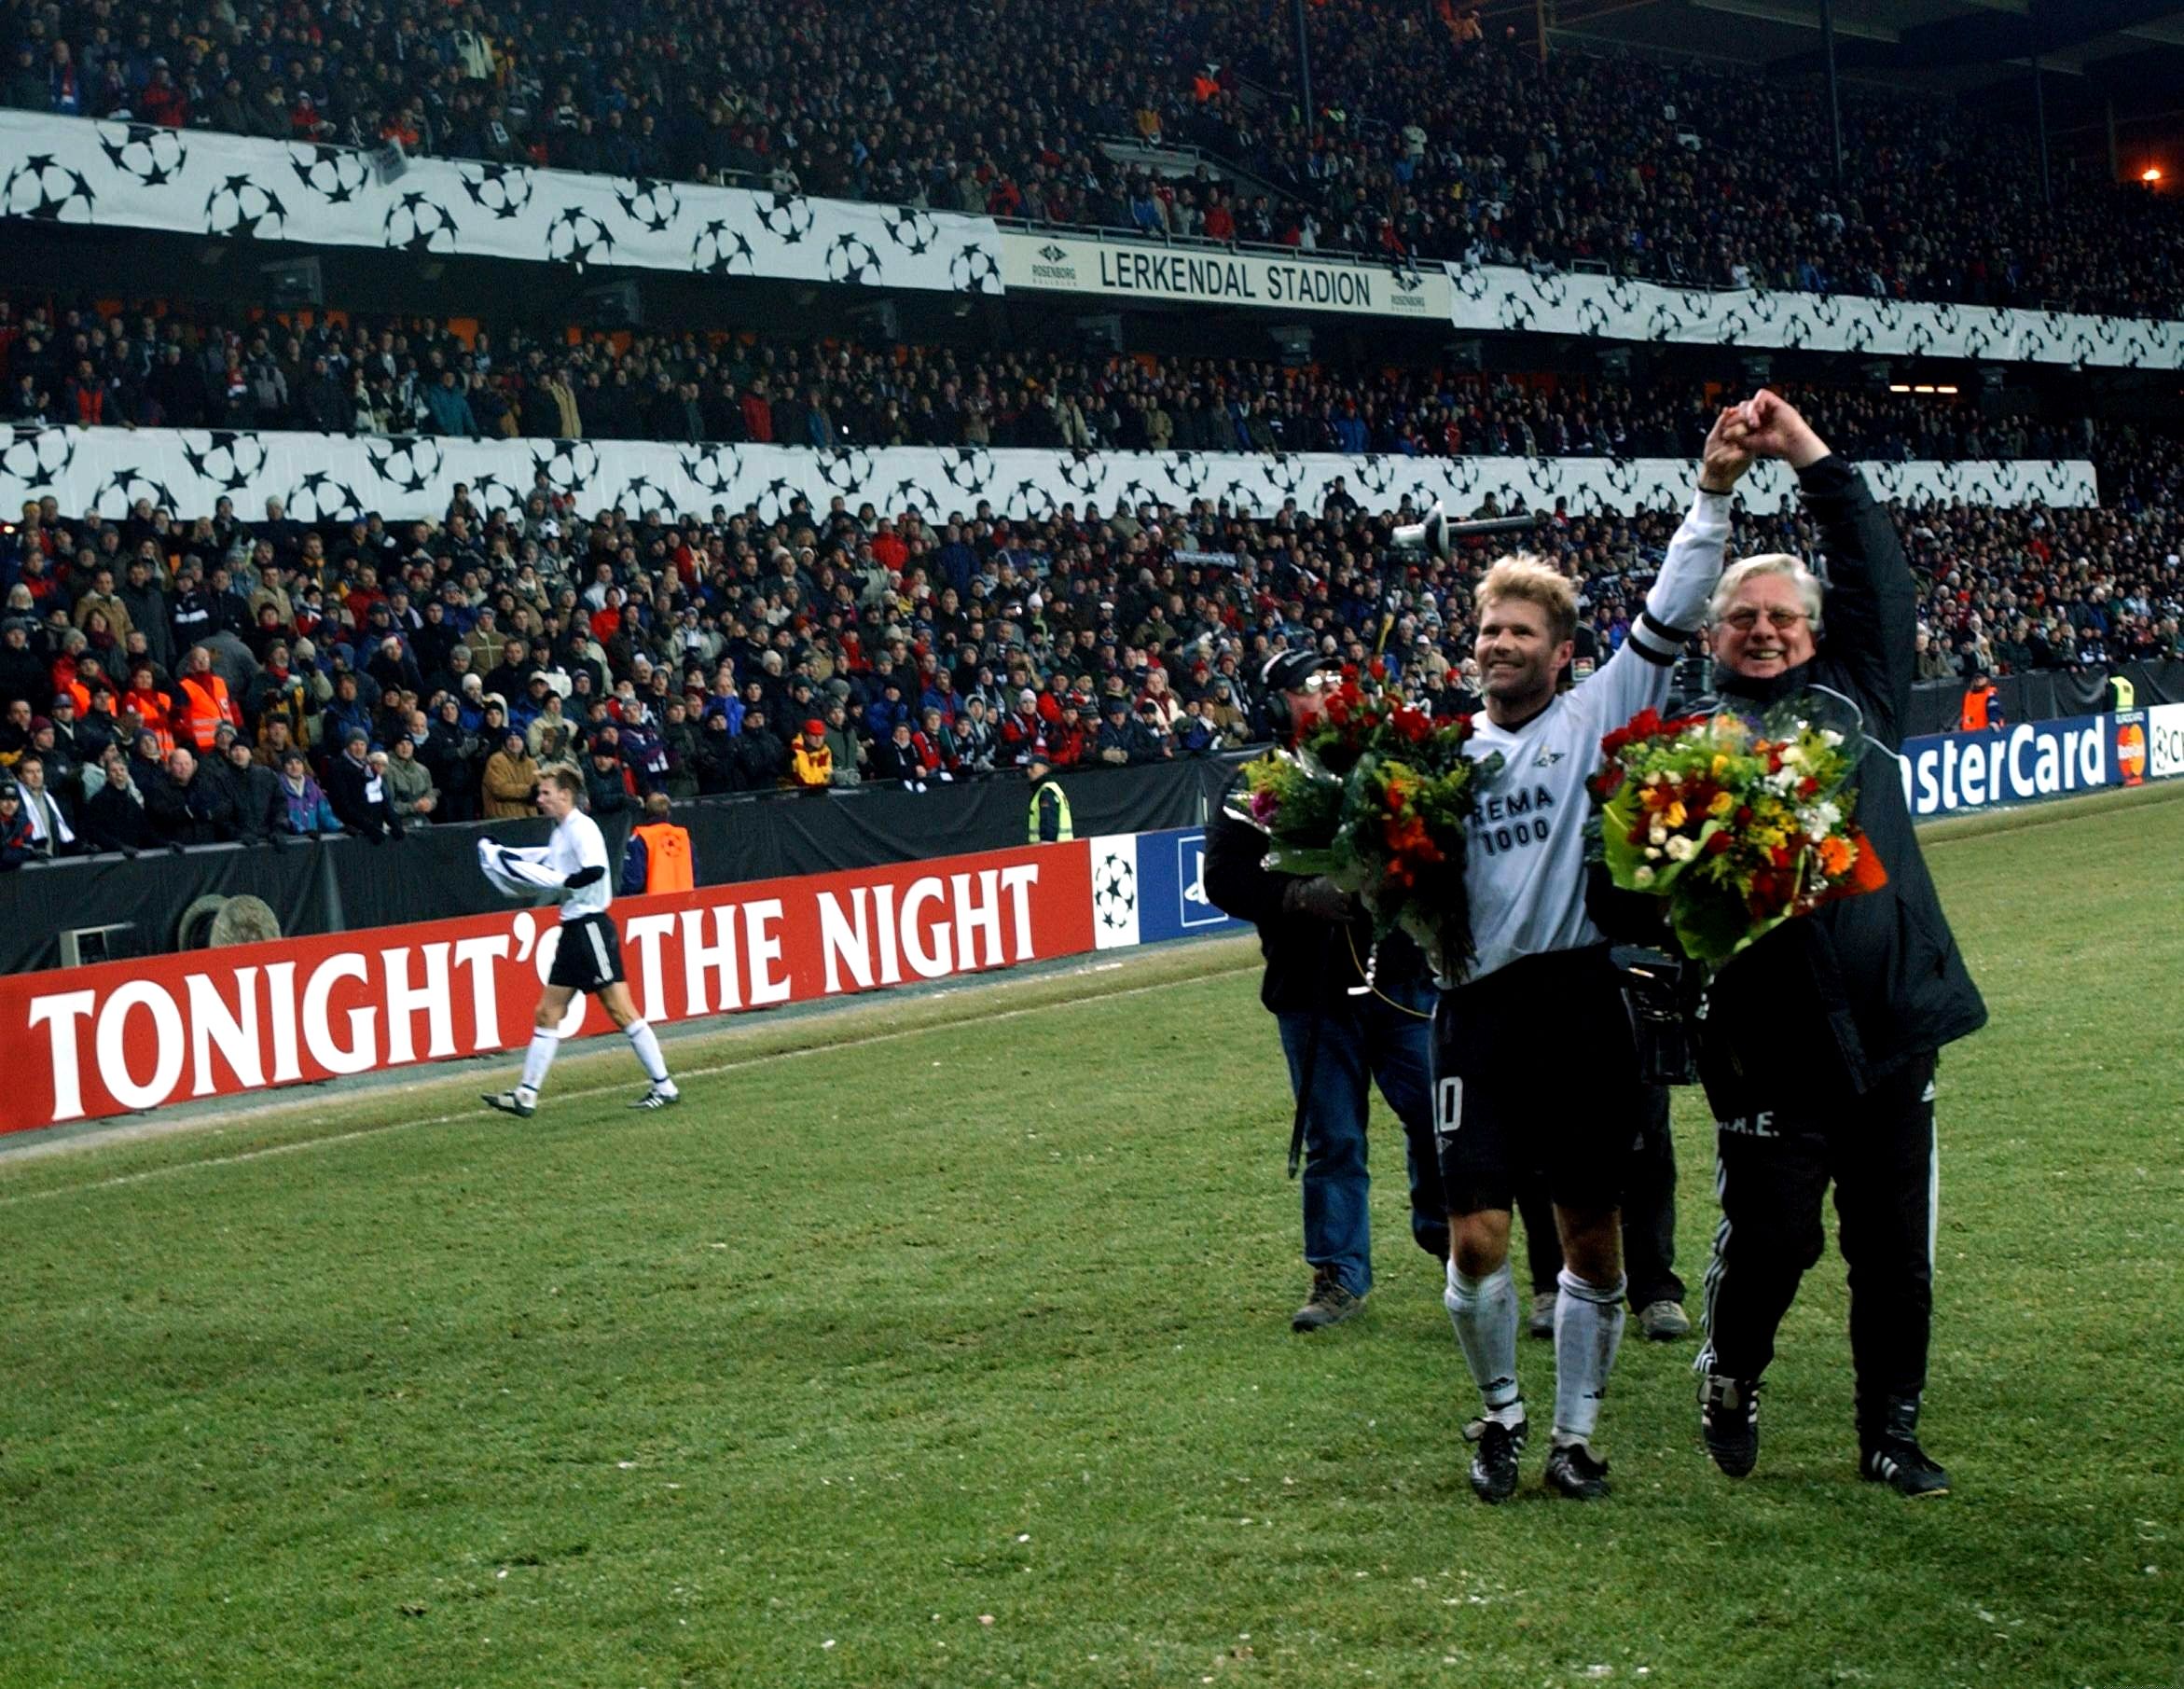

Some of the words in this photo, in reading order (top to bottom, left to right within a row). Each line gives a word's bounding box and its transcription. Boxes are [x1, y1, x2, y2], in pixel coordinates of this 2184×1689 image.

[1100, 250, 1255, 298] LERKENDAL
[1267, 266, 1371, 306] STADION
[1470, 784, 1555, 828] REMA
[1482, 817, 1551, 856] 1000
[625, 898, 791, 1022] THE
[816, 864, 1039, 993] NIGHT
